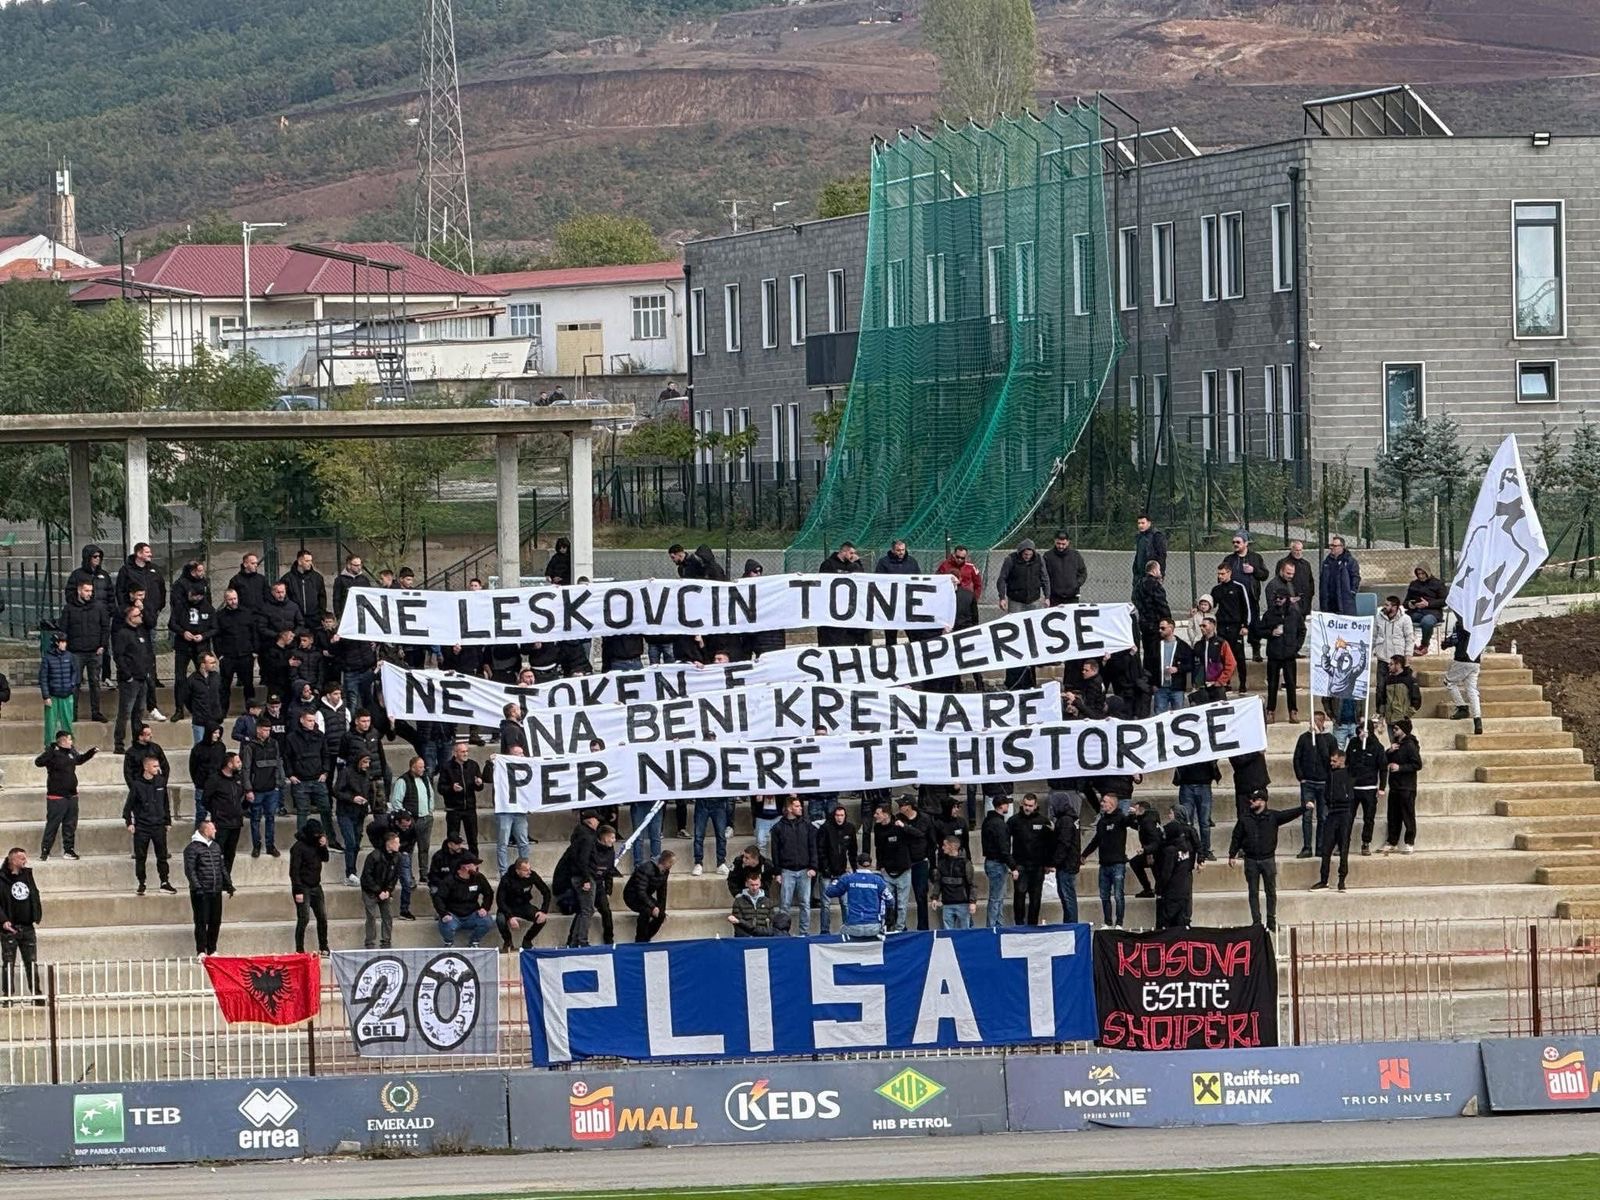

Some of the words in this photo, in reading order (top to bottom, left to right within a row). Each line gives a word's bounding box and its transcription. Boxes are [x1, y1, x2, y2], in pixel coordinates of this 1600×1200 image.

[355, 591, 430, 637] NË
[458, 582, 757, 639] LESKOVCIN
[788, 576, 937, 623] TONË
[1328, 620, 1348, 630] Blue
[405, 669, 475, 718] NË
[797, 602, 1105, 683] SHQIPERISË
[527, 710, 598, 757] NA
[627, 693, 749, 743] BENI
[506, 756, 609, 804] PËR
[638, 736, 821, 795] NDERË
[849, 730, 919, 782] TË
[949, 700, 1241, 778] HISTORISË
[1117, 940, 1251, 978] KOSOVA
[350, 951, 481, 1051] 20
[537, 930, 1076, 1063] PLISAT
[1142, 979, 1230, 1012] ËSHTË
[1102, 1010, 1261, 1051] SHQIPËRI
[1223, 1069, 1300, 1087] Raiffeisen
[1548, 1061, 1586, 1094] albi
[738, 1080, 842, 1121] KEDS
[1064, 1087, 1147, 1108] MOKNE
[1225, 1088, 1273, 1105] BANK
[1342, 1095, 1389, 1105] TRION
[1397, 1092, 1452, 1103] INVEST
[128, 1107, 182, 1126] TEB
[367, 1117, 435, 1131] EMERALD
[575, 1098, 611, 1134] albi
[617, 1106, 698, 1132] MALL
[873, 1119, 897, 1130] HIB
[900, 1117, 952, 1129] PETROL
[90, 1147, 118, 1155] PARIBAS
[239, 1128, 299, 1149] errea
